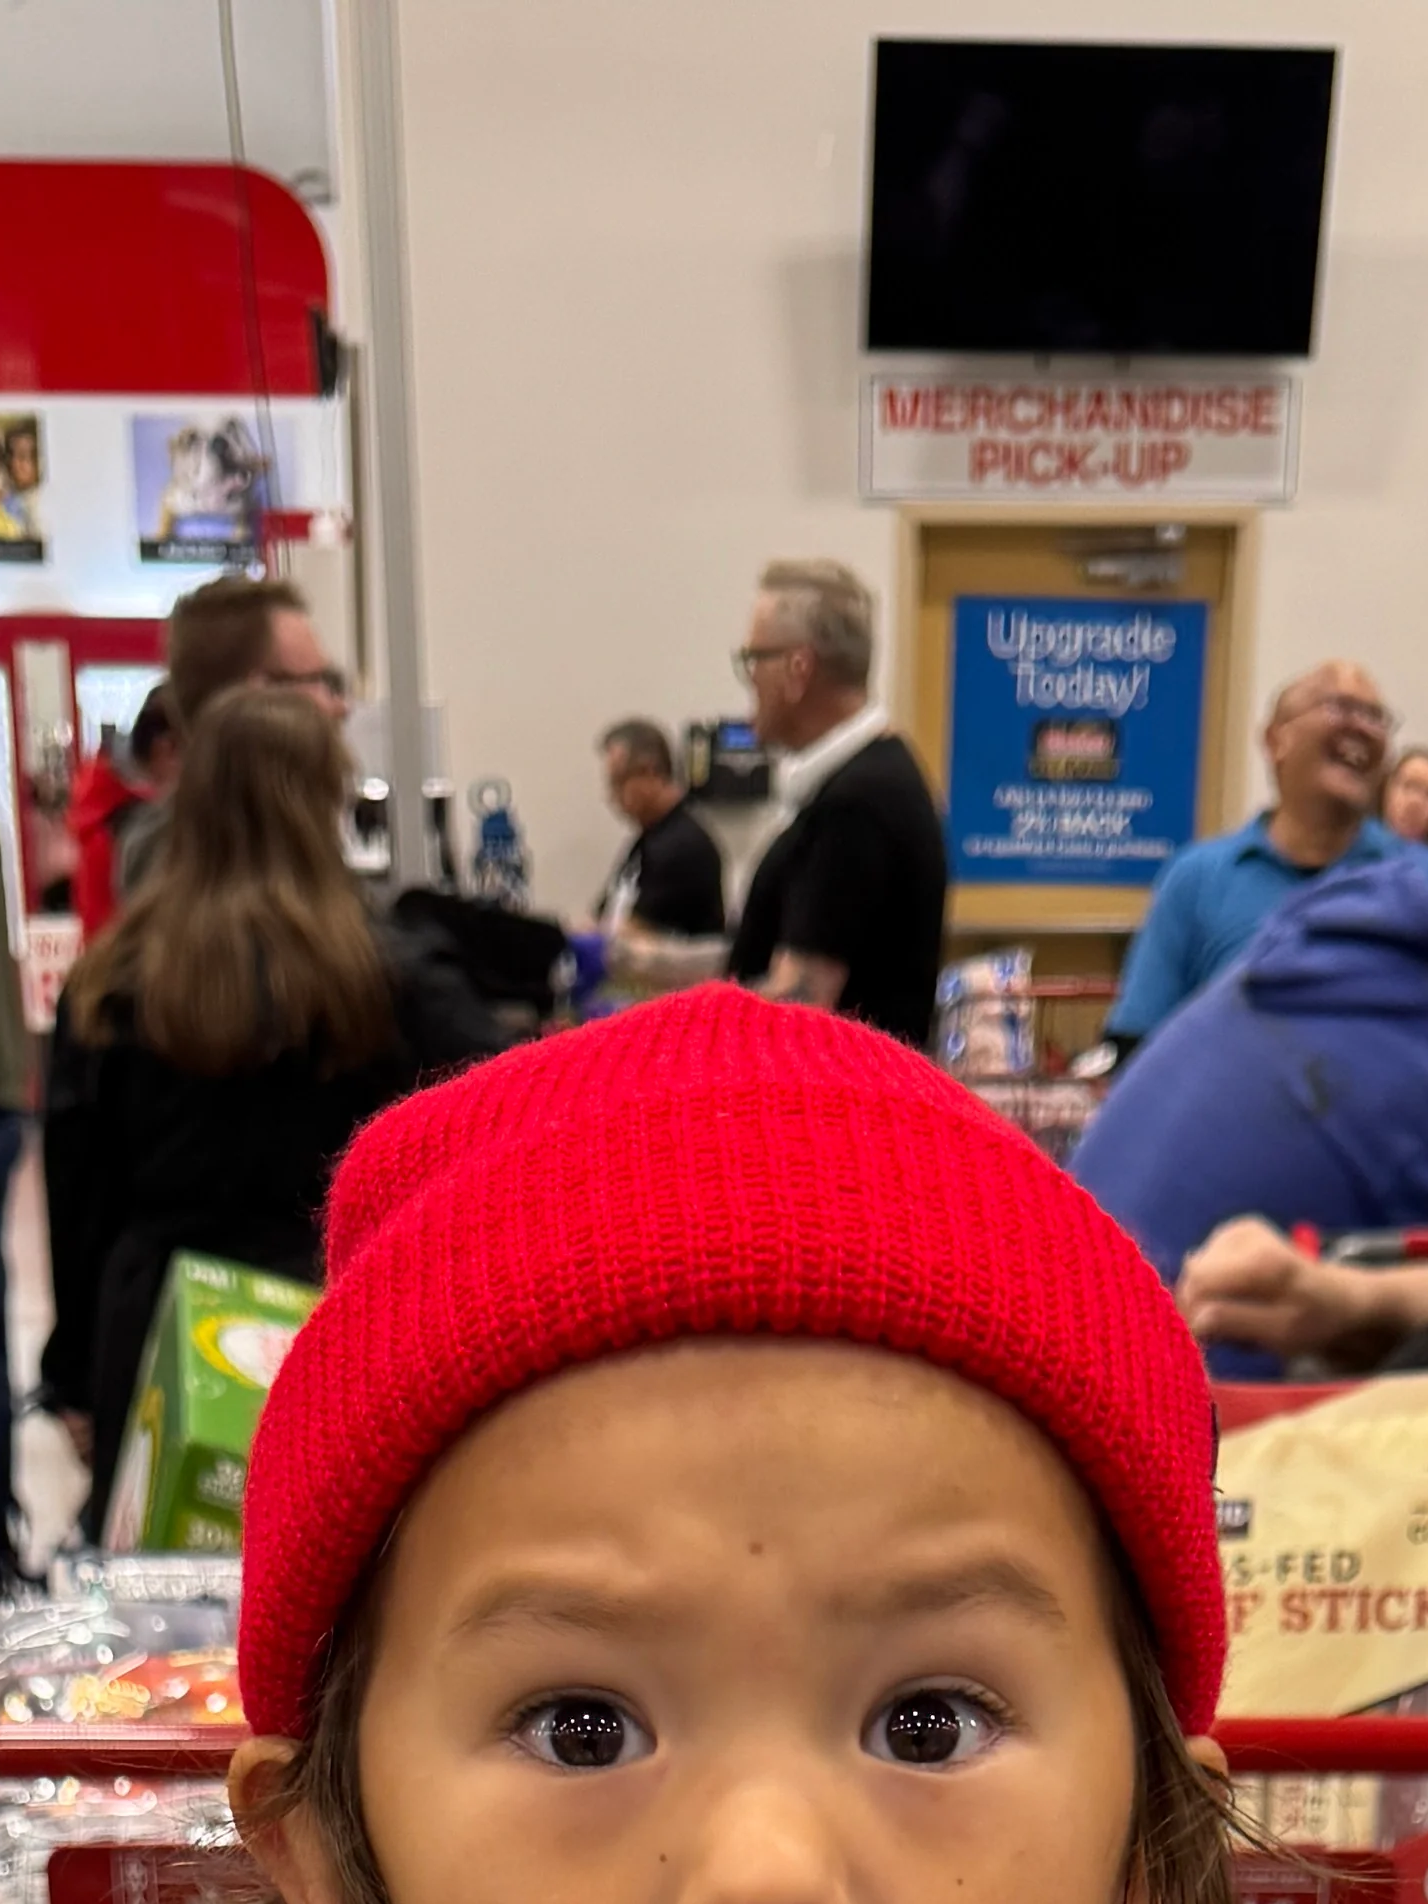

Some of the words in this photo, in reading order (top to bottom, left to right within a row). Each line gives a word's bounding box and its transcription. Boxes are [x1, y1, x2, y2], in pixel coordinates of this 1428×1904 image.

[880, 385, 1285, 436] MERCHANDISE
[970, 439, 1192, 487] PICK-UP
[987, 608, 1176, 667] Upgrade
[1010, 661, 1150, 718] Today!
